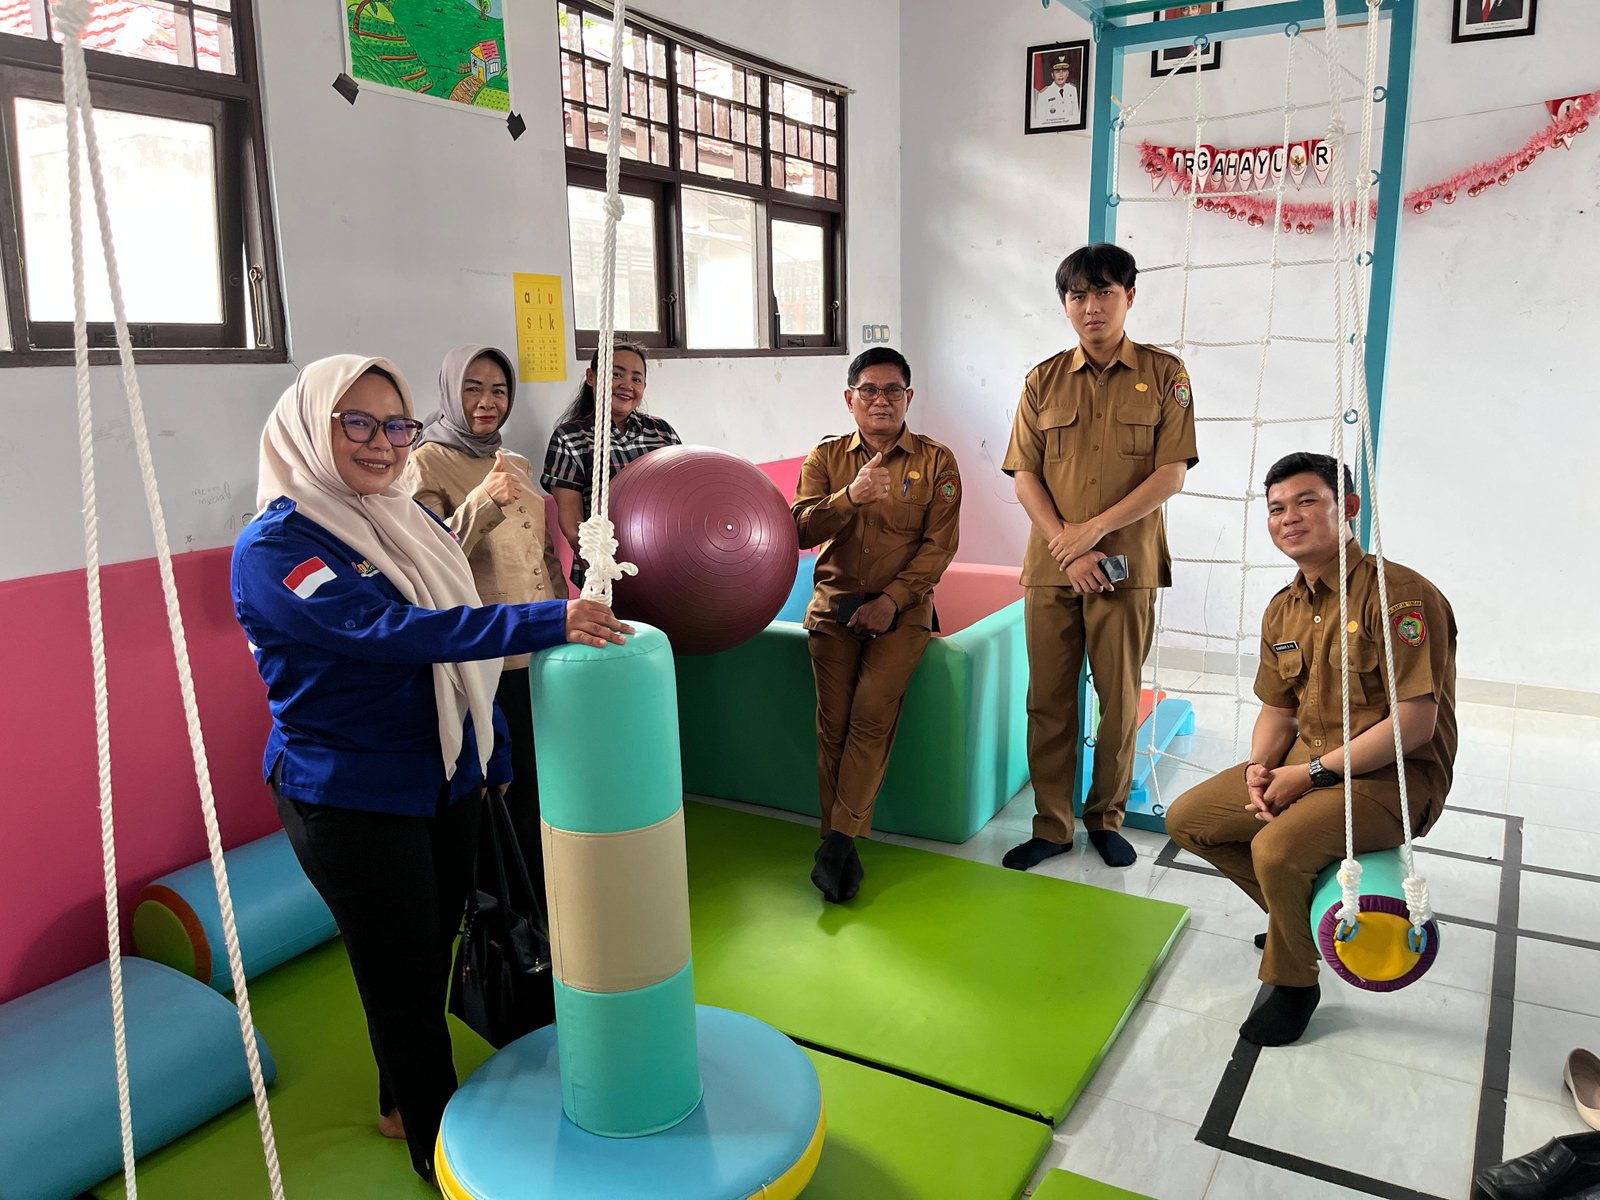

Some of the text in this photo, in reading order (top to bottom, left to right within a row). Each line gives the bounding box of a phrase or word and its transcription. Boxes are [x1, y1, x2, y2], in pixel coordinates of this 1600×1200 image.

[1316, 146, 1328, 166] R
[524, 291, 531, 304] a
[547, 292, 553, 305] u
[548, 313, 555, 330] k
